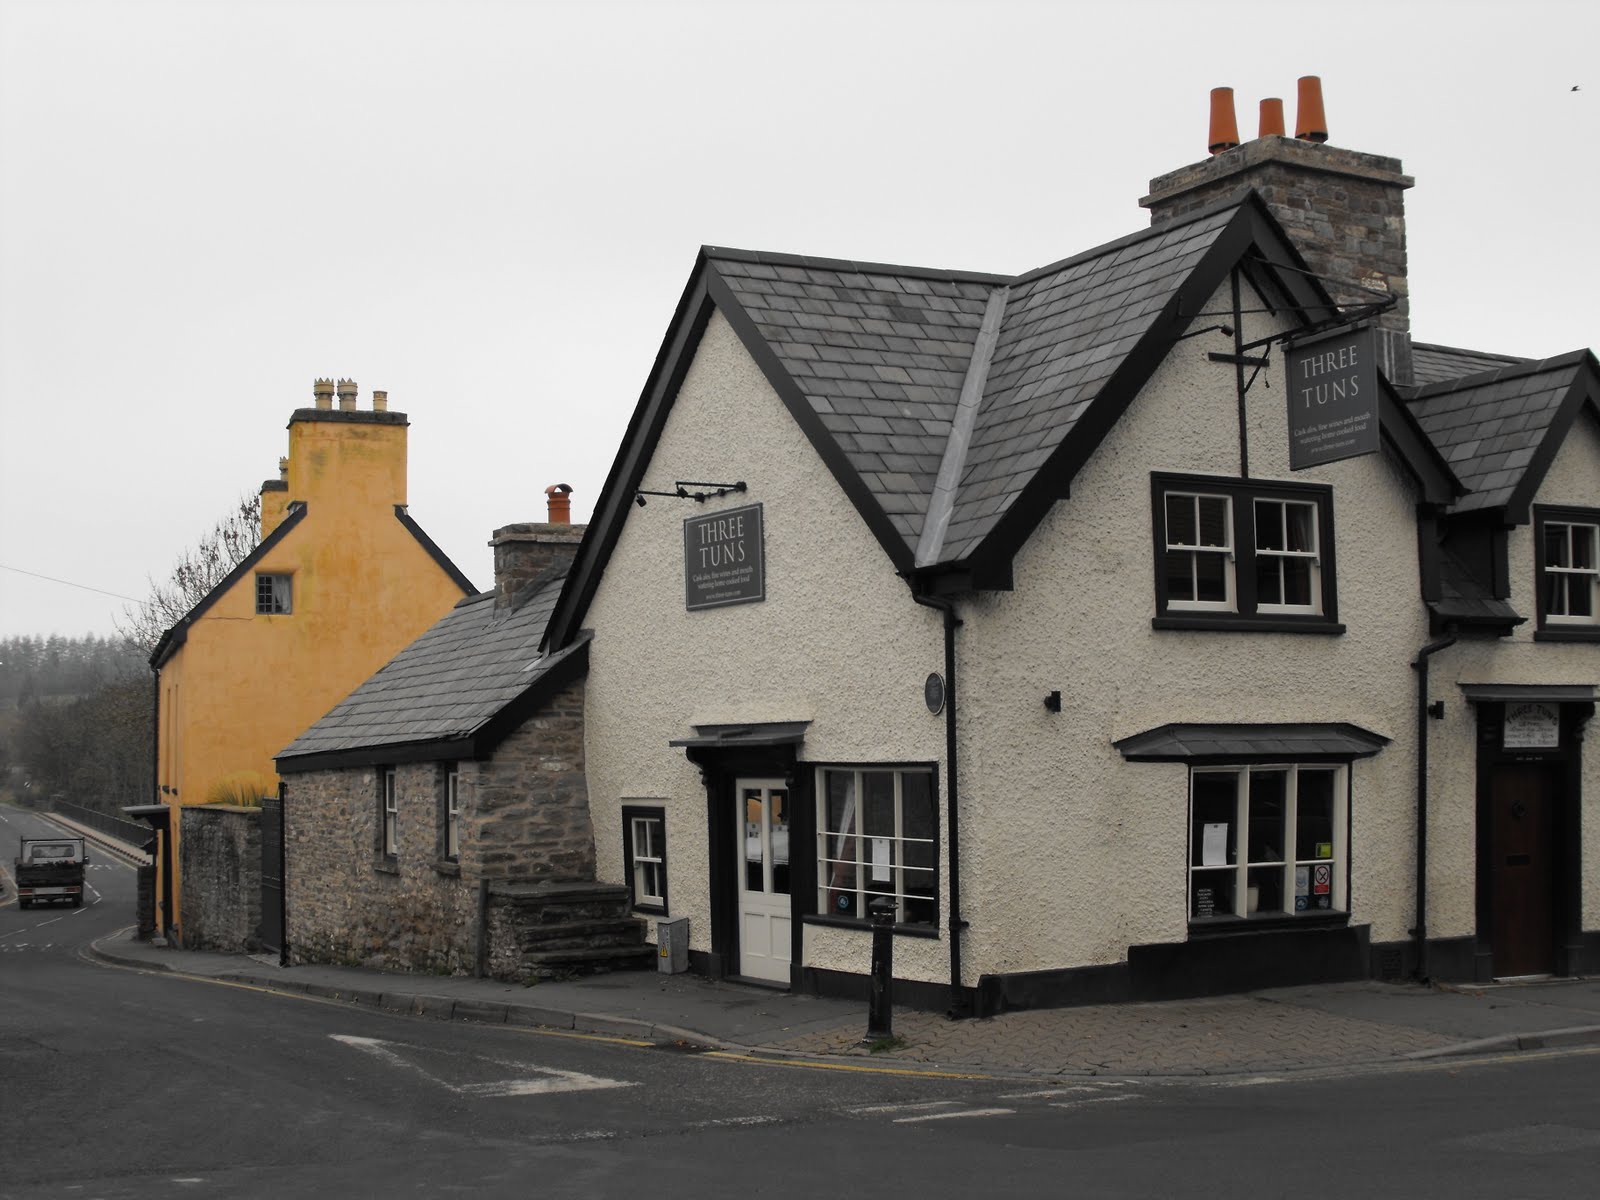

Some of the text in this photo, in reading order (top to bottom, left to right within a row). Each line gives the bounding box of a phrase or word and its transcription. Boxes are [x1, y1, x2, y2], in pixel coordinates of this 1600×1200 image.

[1300, 345, 1358, 378] THREE
[1302, 375, 1359, 408] TUNS
[1318, 423, 1328, 431] fine
[1343, 415, 1353, 425] and
[1354, 411, 1371, 422] mouth
[1321, 432, 1336, 440] home
[1336, 424, 1354, 436] cooked
[1354, 422, 1367, 432] food
[698, 516, 744, 544] THREE
[700, 540, 745, 568] TUNS
